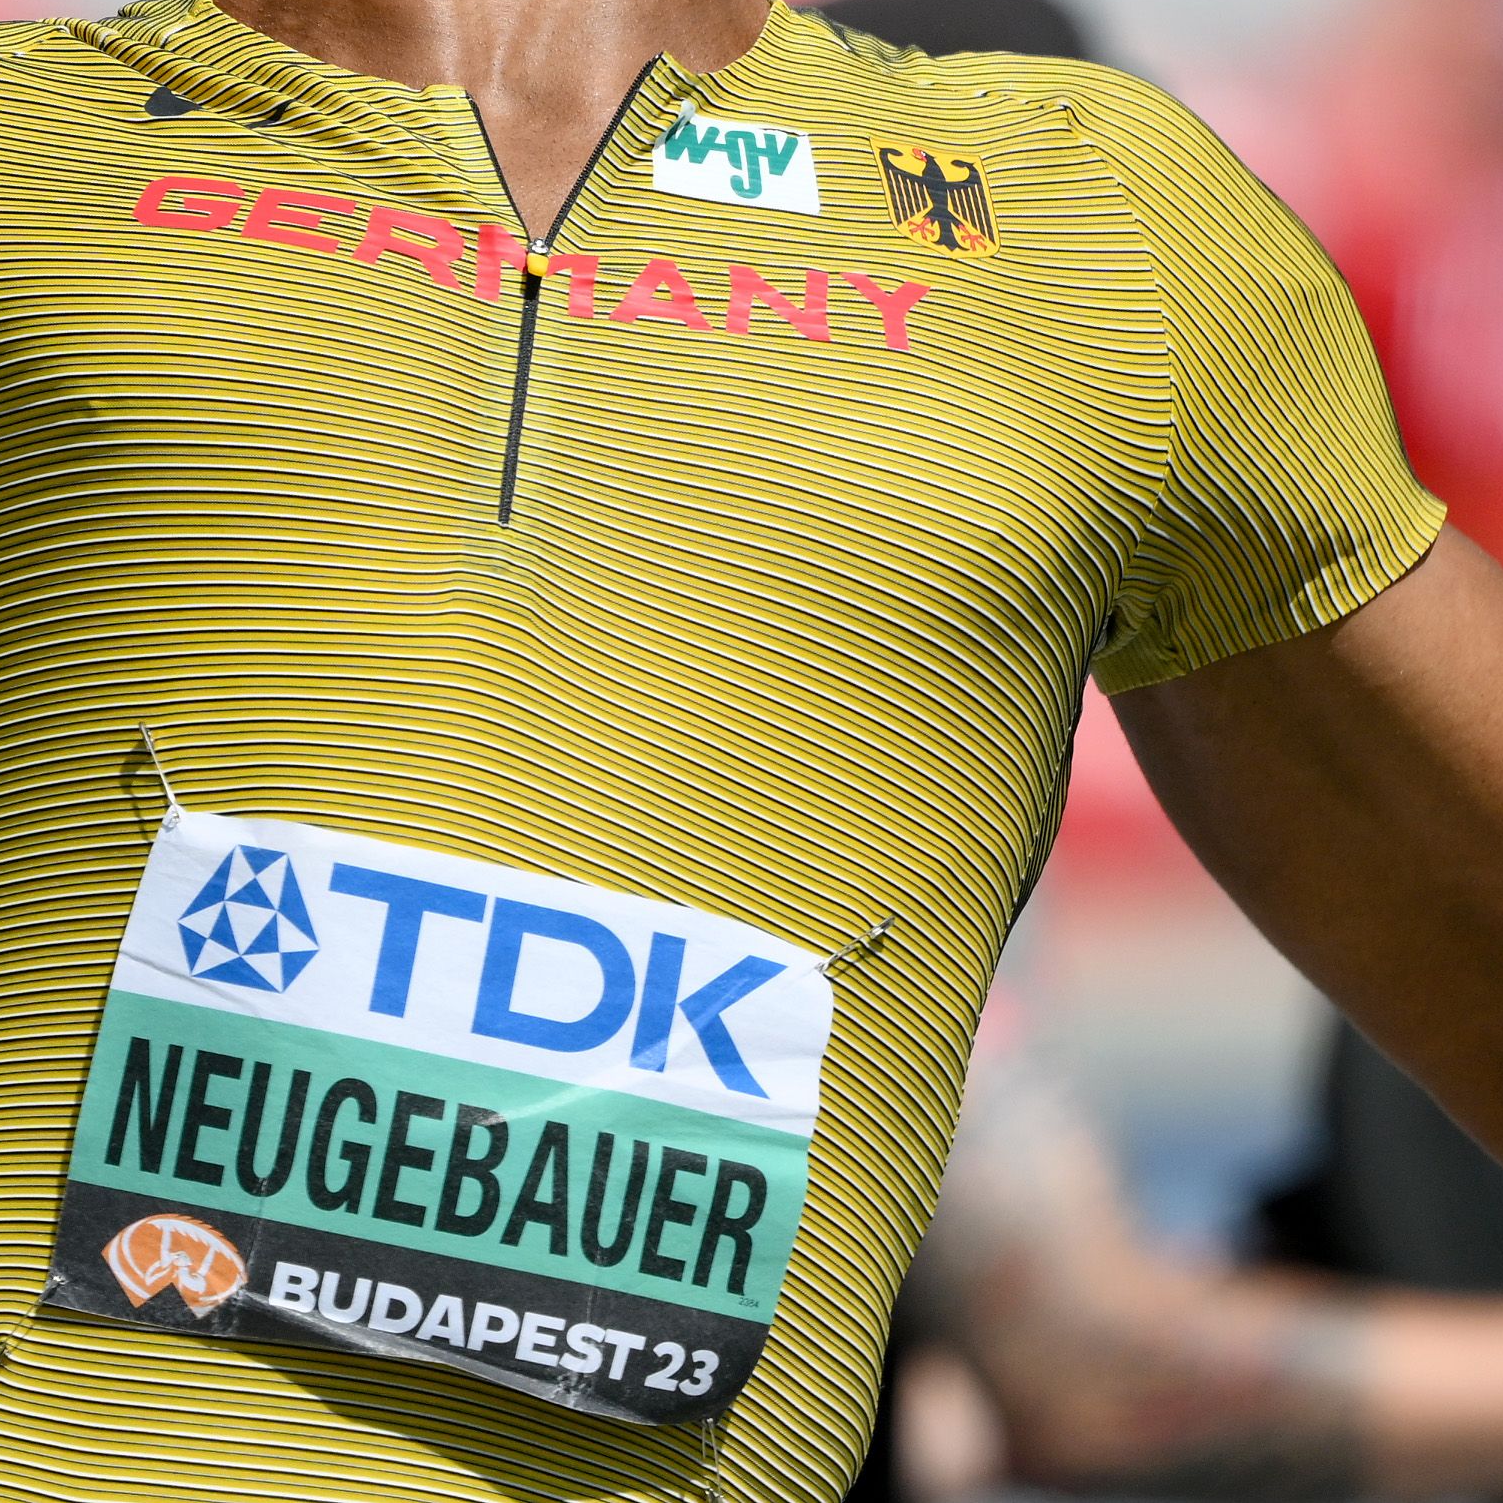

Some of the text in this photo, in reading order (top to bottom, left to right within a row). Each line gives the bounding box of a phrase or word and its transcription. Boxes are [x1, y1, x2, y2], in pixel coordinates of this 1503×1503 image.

[134, 177, 930, 350] GERMANY
[329, 862, 787, 1100] TDK
[105, 1037, 767, 1296] NEUGEBAUER
[268, 1262, 718, 1395] BUDAPEST 23
